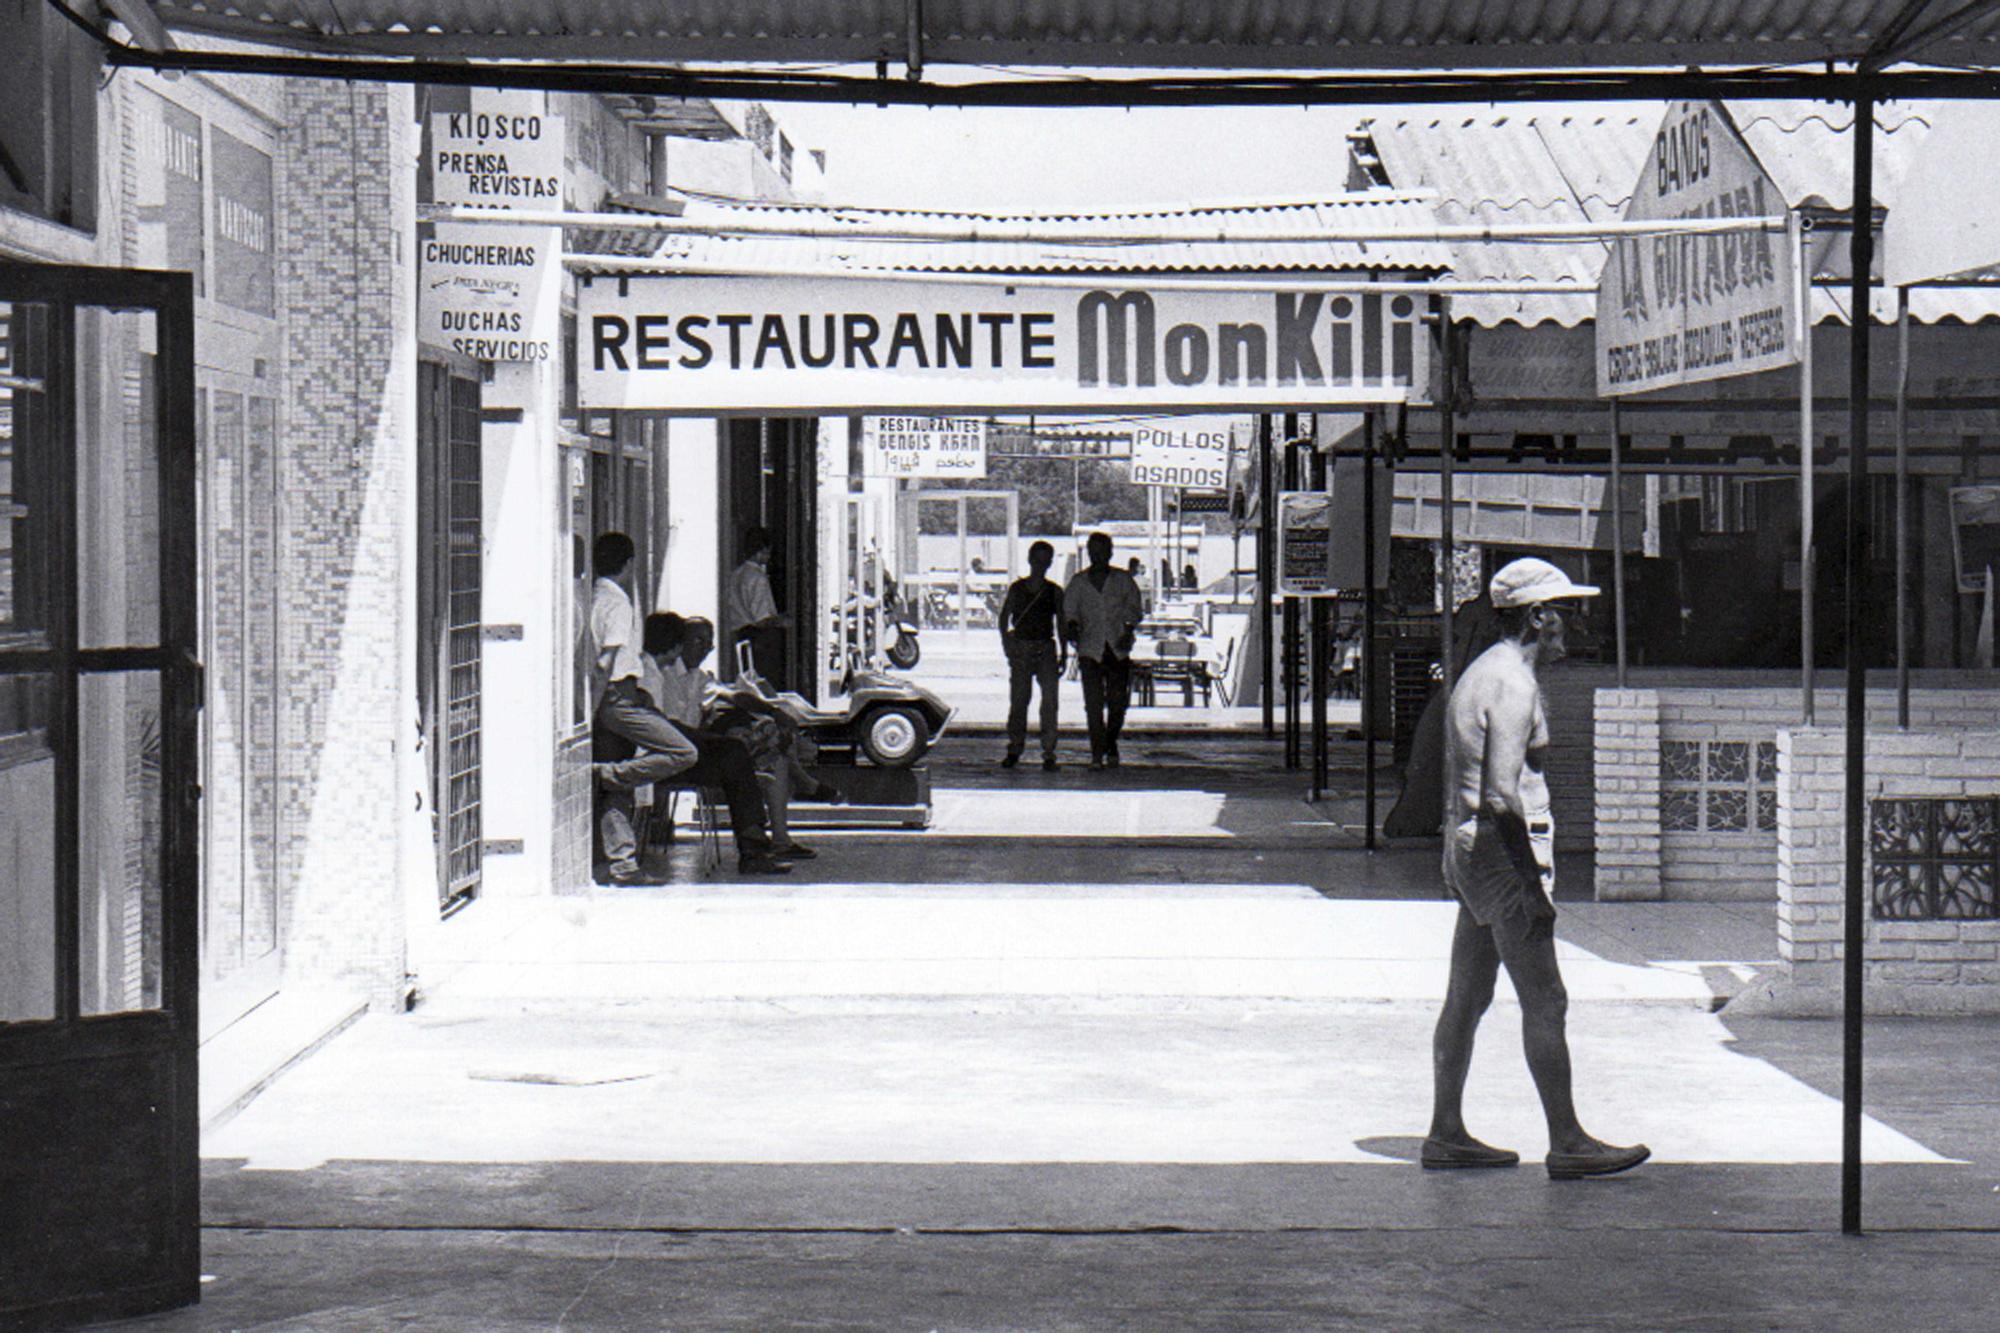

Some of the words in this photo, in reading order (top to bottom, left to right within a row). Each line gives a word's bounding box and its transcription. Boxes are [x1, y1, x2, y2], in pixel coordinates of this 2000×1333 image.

[450, 113, 541, 140] KIOSCO
[439, 152, 509, 174] PRENSA
[469, 174, 558, 197] REVISTAS
[426, 243, 536, 267] CHUCHERIAS
[441, 310, 522, 332] DUCHAS
[452, 337, 549, 361] SERVICIOS
[592, 312, 1056, 371] RESTAURANTE
[879, 417, 980, 433] RESTAURANTES
[1136, 429, 1225, 451] POLLOS
[1134, 465, 1224, 486] ASADOS
